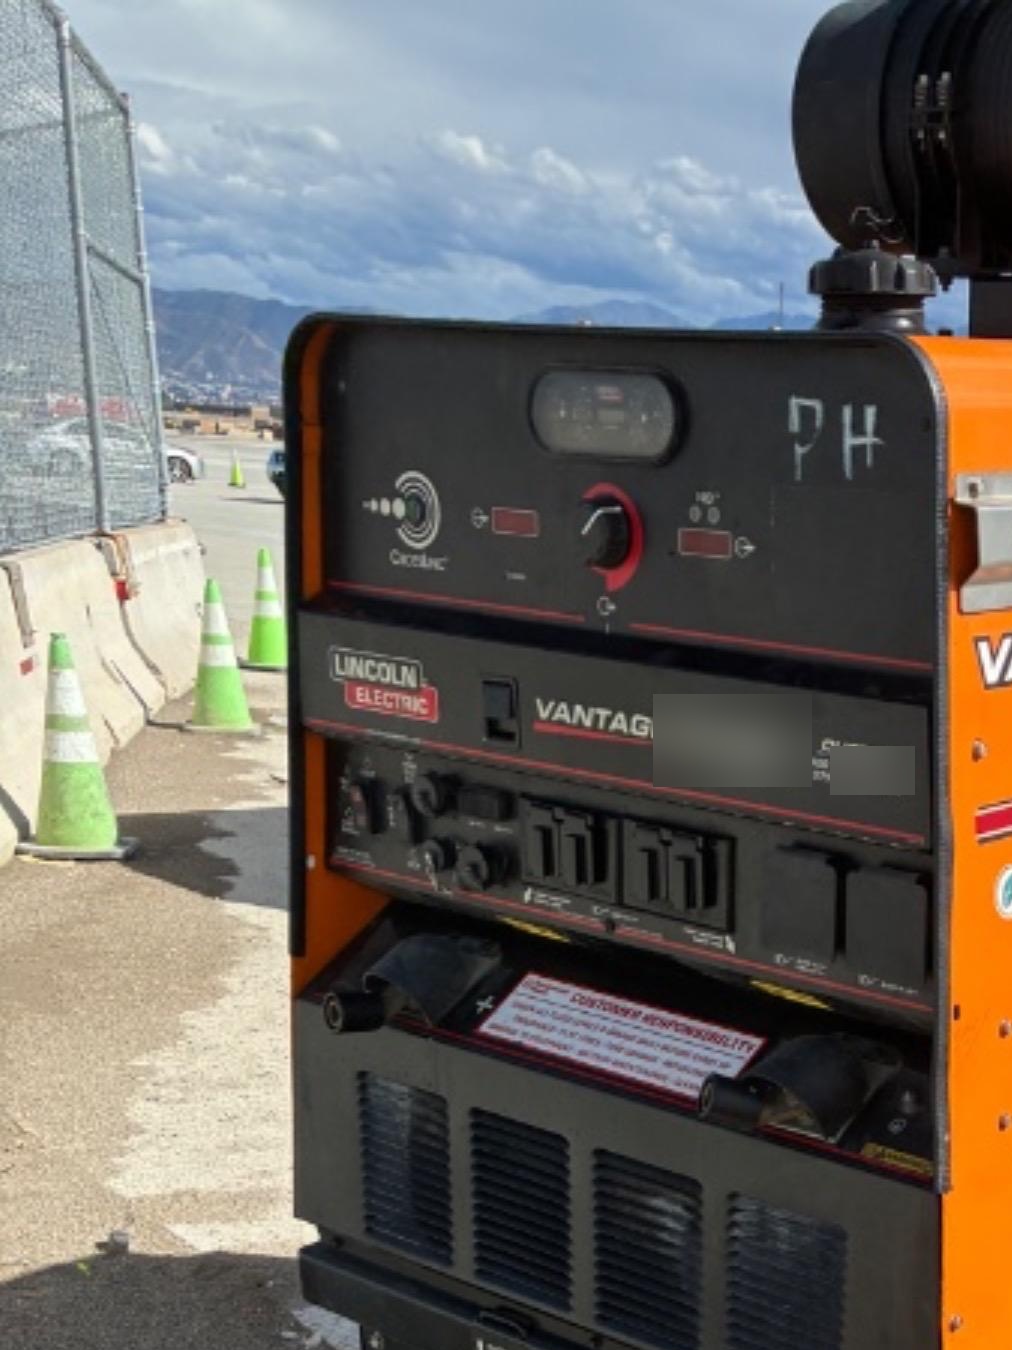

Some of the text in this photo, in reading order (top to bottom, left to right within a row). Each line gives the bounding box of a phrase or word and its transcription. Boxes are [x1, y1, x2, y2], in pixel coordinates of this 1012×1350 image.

[334, 653, 418, 689] LINCOLN
[355, 685, 430, 716] ELECTRIC
[534, 696, 654, 739] VANTAG
[569, 990, 642, 1021] CUSTOMER
[641, 1009, 759, 1053] RESPONSIBILITY
